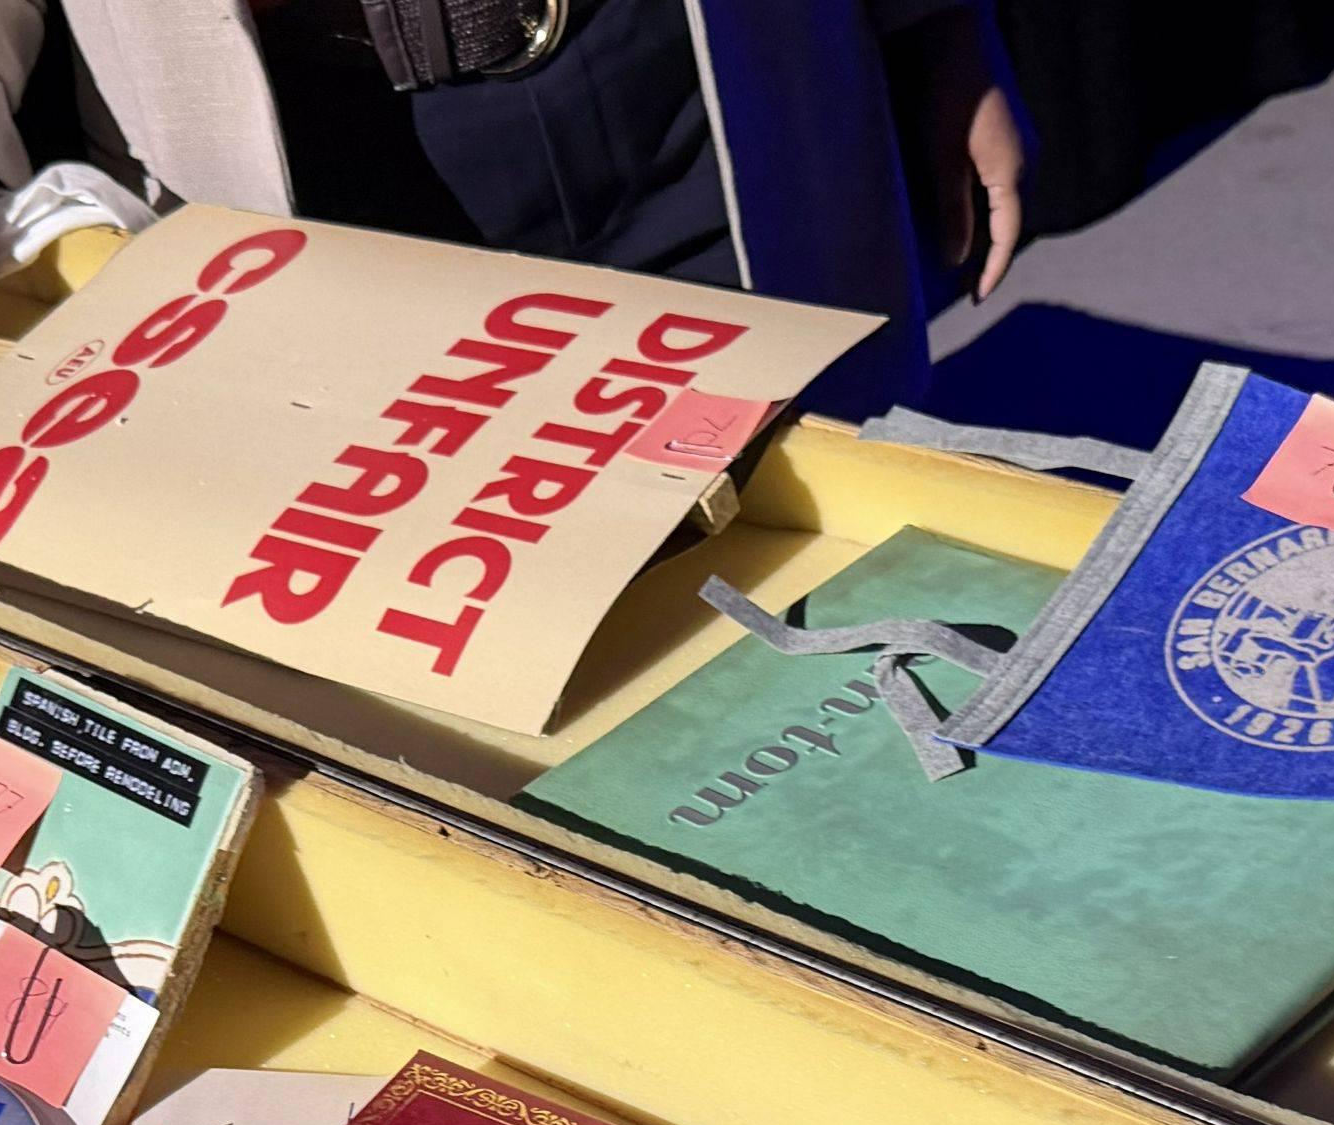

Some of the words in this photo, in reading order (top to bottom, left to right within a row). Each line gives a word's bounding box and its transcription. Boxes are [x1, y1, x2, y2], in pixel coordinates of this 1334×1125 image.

[221, 292, 614, 623] UNFAIR
[375, 313, 749, 676] DISTRICT
[1175, 618, 1214, 671] SAN
[5, 718, 46, 748] BLDG.
[51, 740, 102, 774] BEFORE
[104, 764, 193, 817] REMODELING
[21, 690, 81, 727] SPANISH
[83, 718, 118, 746] TILE
[120, 736, 161, 764] FROM
